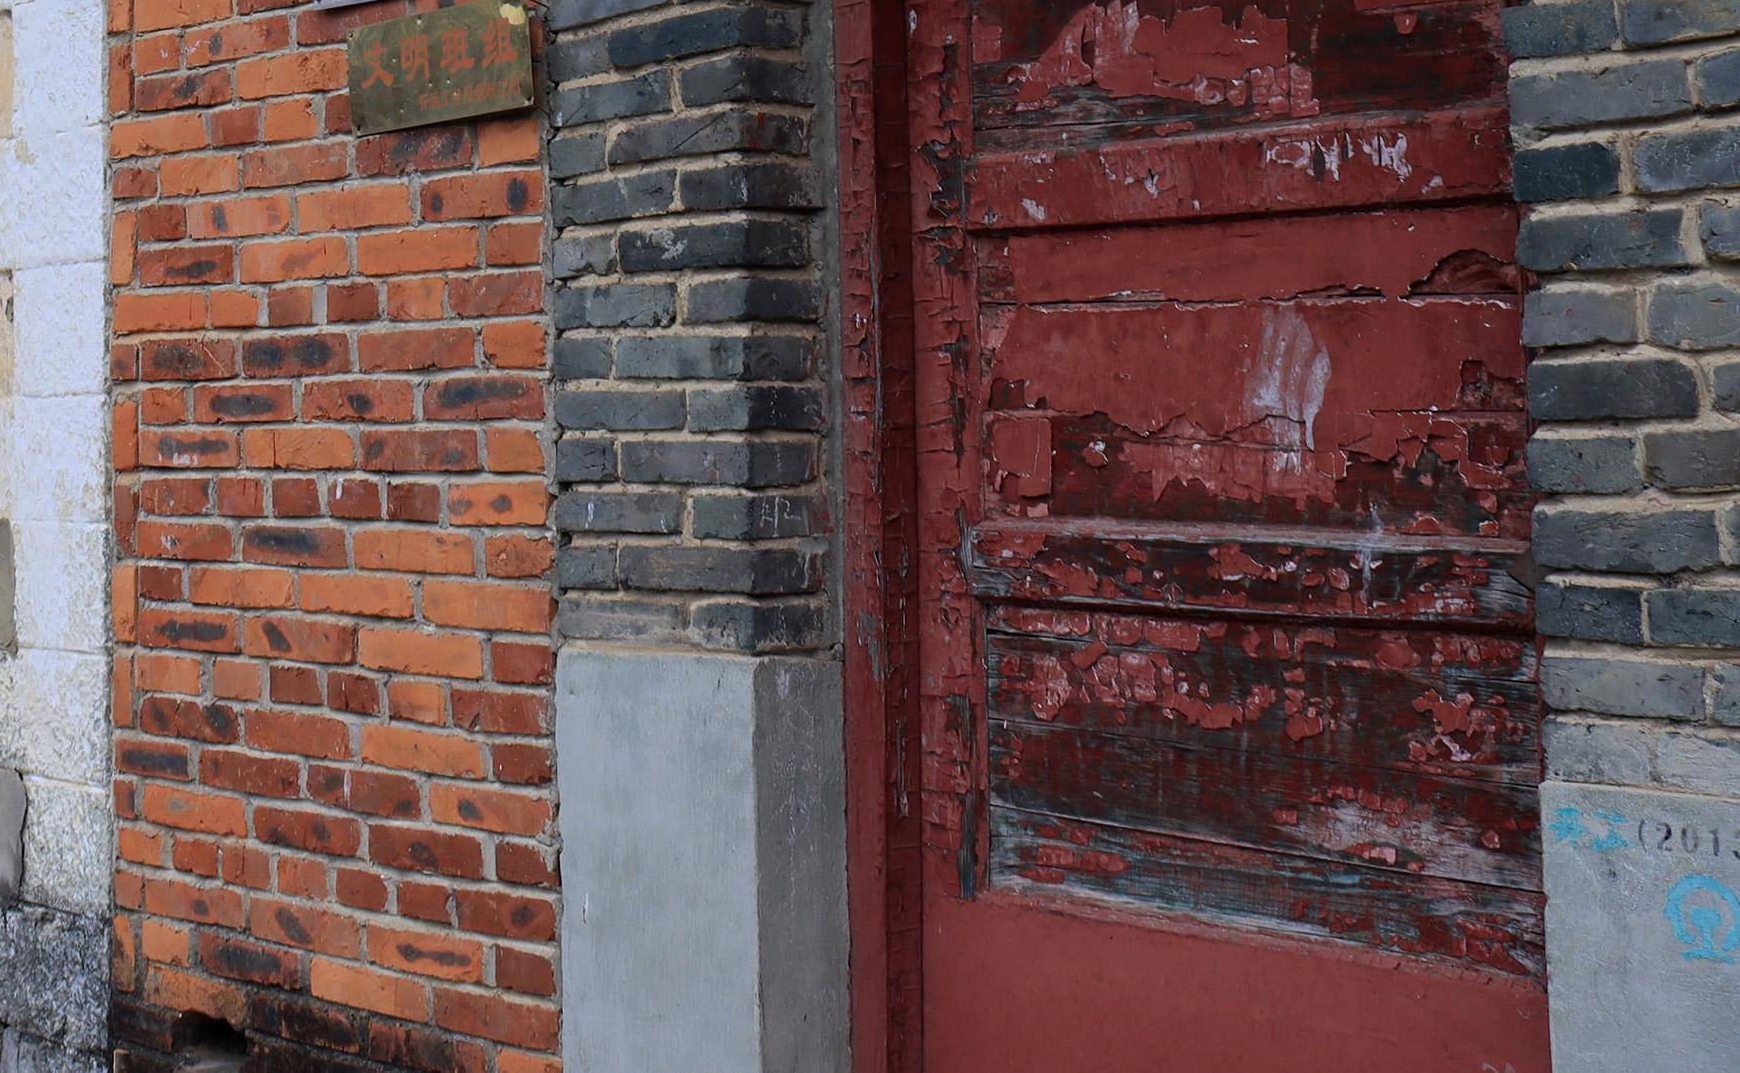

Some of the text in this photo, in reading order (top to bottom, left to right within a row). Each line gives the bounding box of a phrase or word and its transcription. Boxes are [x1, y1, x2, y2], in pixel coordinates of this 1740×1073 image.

[361, 17, 517, 89] 文明班组
[1639, 819, 1740, 860] (201
